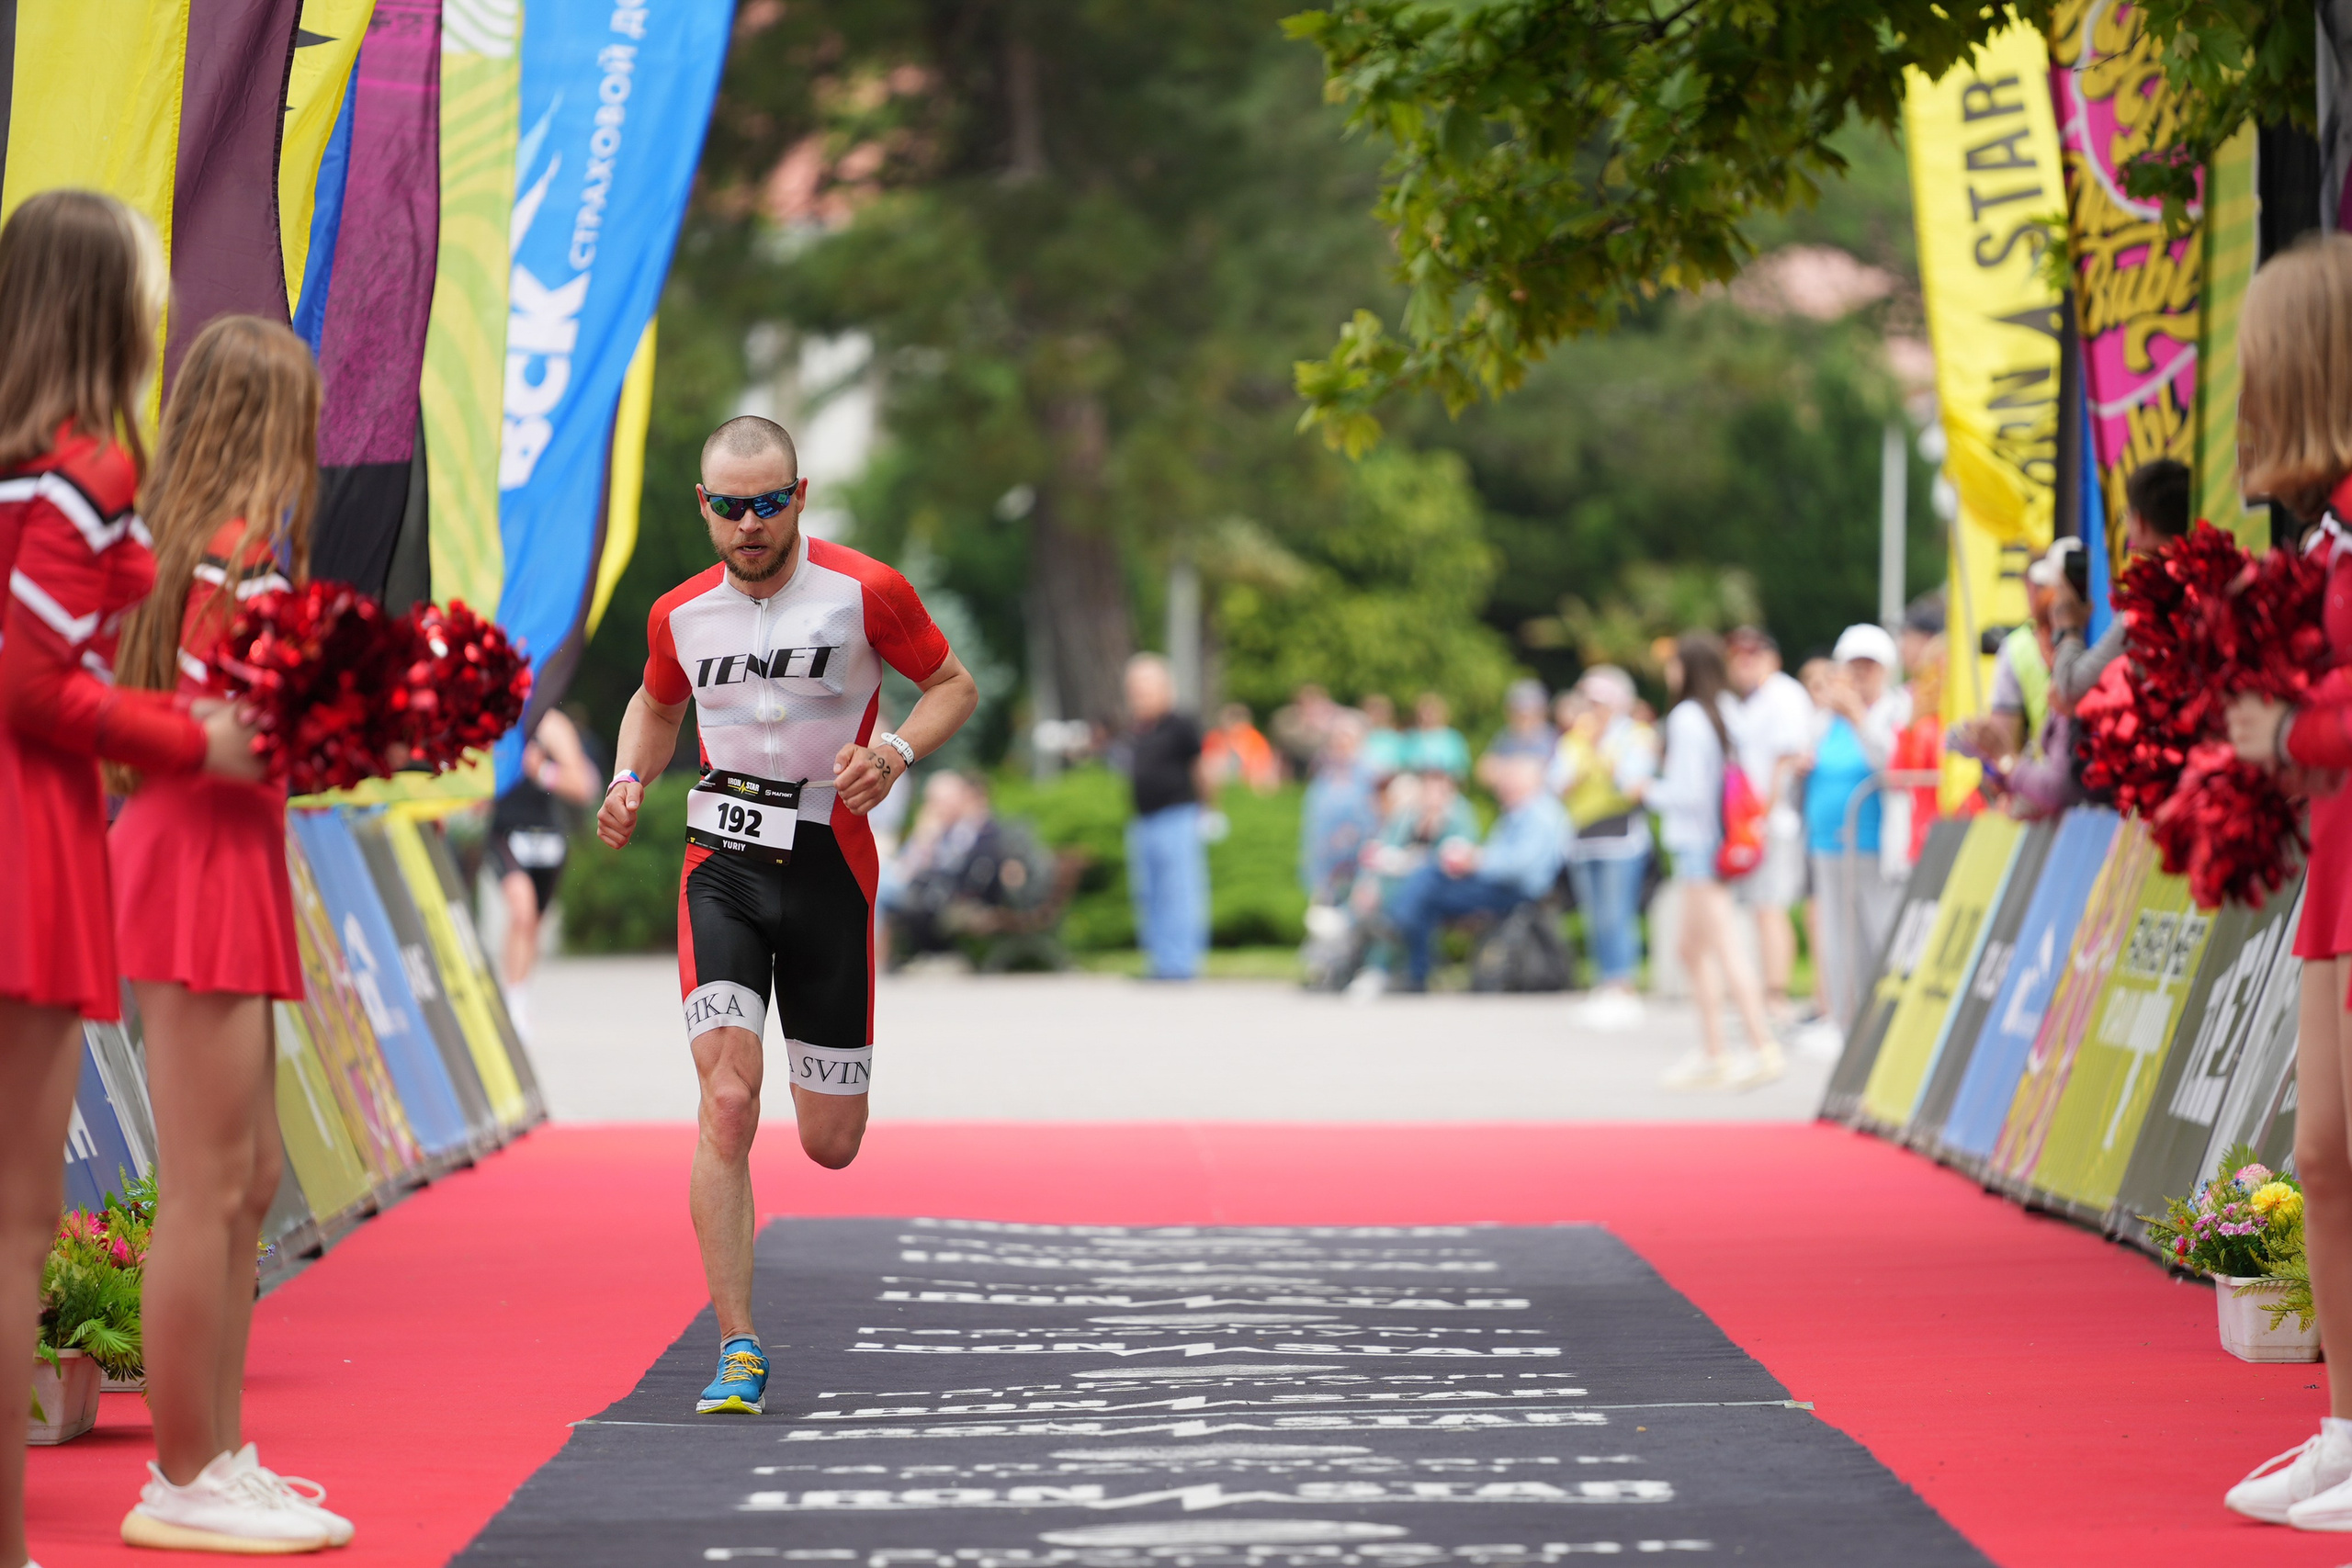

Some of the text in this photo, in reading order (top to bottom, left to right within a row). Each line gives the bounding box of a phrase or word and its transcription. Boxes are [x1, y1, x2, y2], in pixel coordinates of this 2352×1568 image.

[569, 0, 650, 271] СТРАХОВОЙ Д
[1963, 76, 2051, 267] STAR
[497, 263, 593, 491] ВСК
[695, 646, 841, 688] TENET
[727, 777, 742, 787] IRON
[746, 781, 760, 792] STAR
[718, 802, 763, 839] 192
[722, 840, 746, 852] YURIY
[881, 1291, 1532, 1308] IRON STAR
[854, 1342, 1564, 1355] IRON STAR
[805, 1388, 1589, 1417] IRON STAR
[786, 1412, 1609, 1439] IRON STAR
[747, 1480, 1675, 1505] IRON STAR
